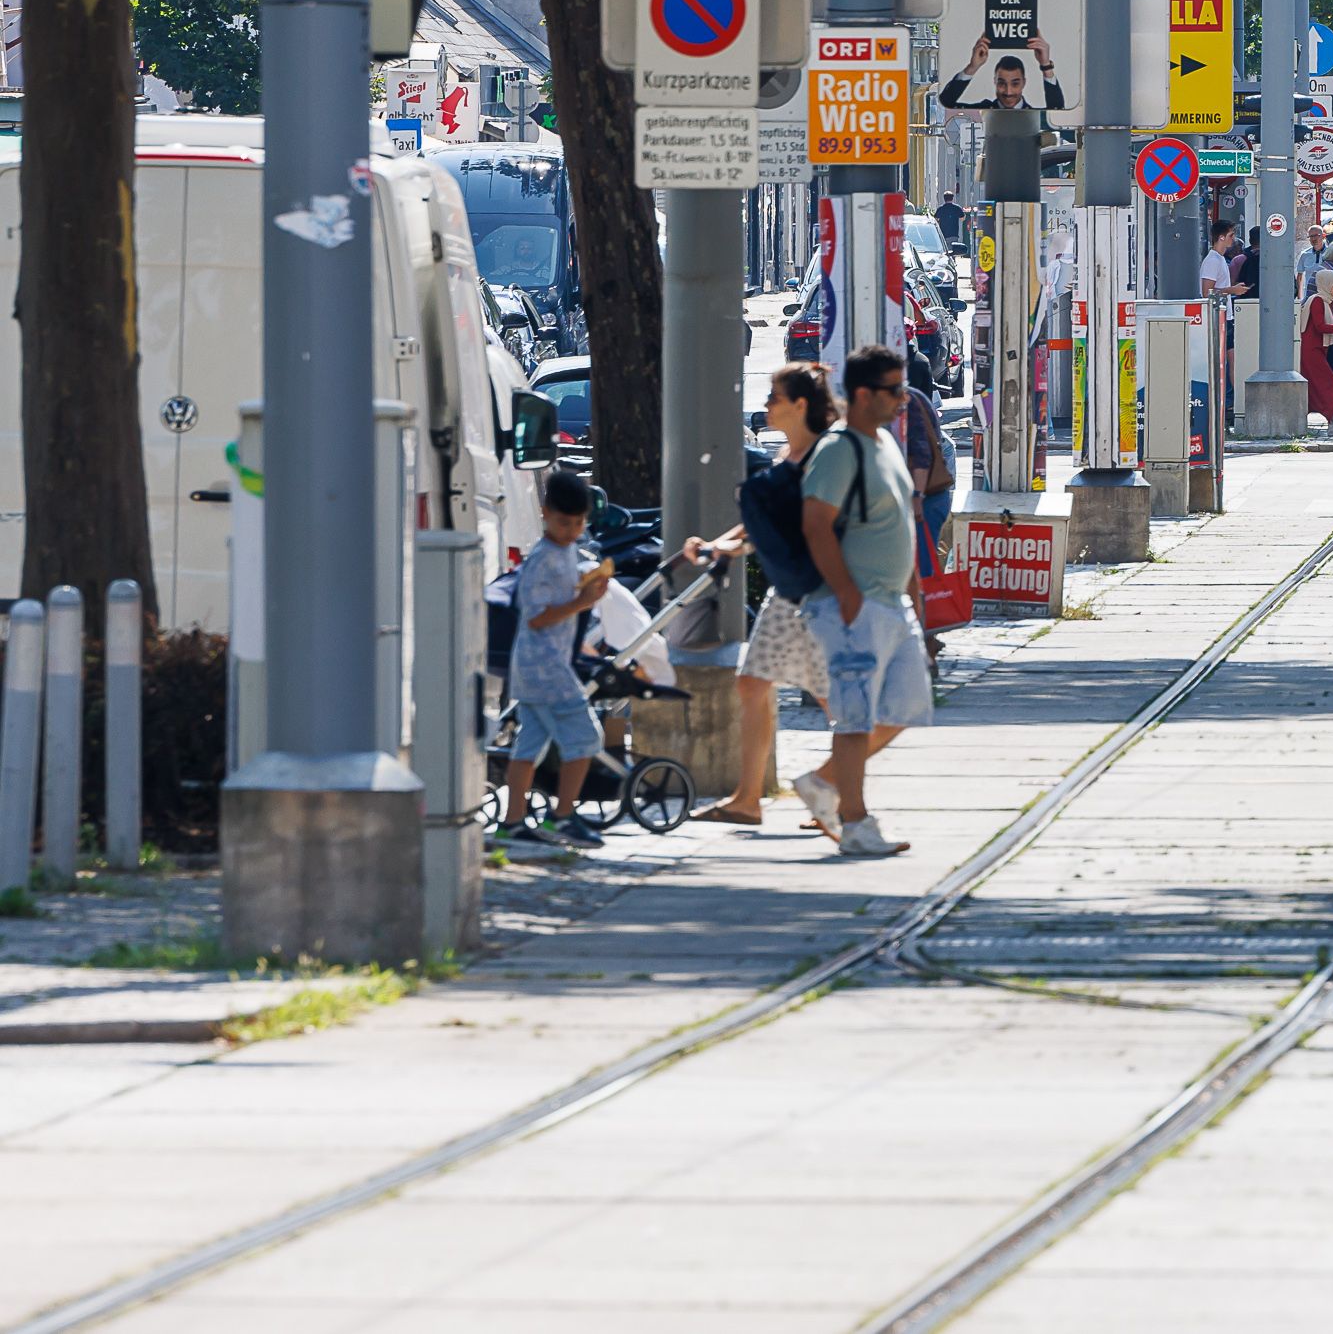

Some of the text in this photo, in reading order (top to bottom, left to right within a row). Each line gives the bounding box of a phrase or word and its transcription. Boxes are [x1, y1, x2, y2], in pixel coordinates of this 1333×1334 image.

[989, 9, 1032, 20] RICHTIGE
[992, 23, 1029, 38] WEG
[821, 41, 869, 58] ORF
[398, 80, 427, 98] Stiegl
[642, 70, 751, 92] Kurzparkzone
[817, 72, 899, 102] Radio
[818, 104, 895, 134] Wien
[392, 137, 415, 151] Taxi
[1199, 158, 1235, 166] Schwechat
[1155, 192, 1180, 202] ENDE
[969, 530, 1050, 562] Kronen
[969, 560, 1050, 595] Zeitung
